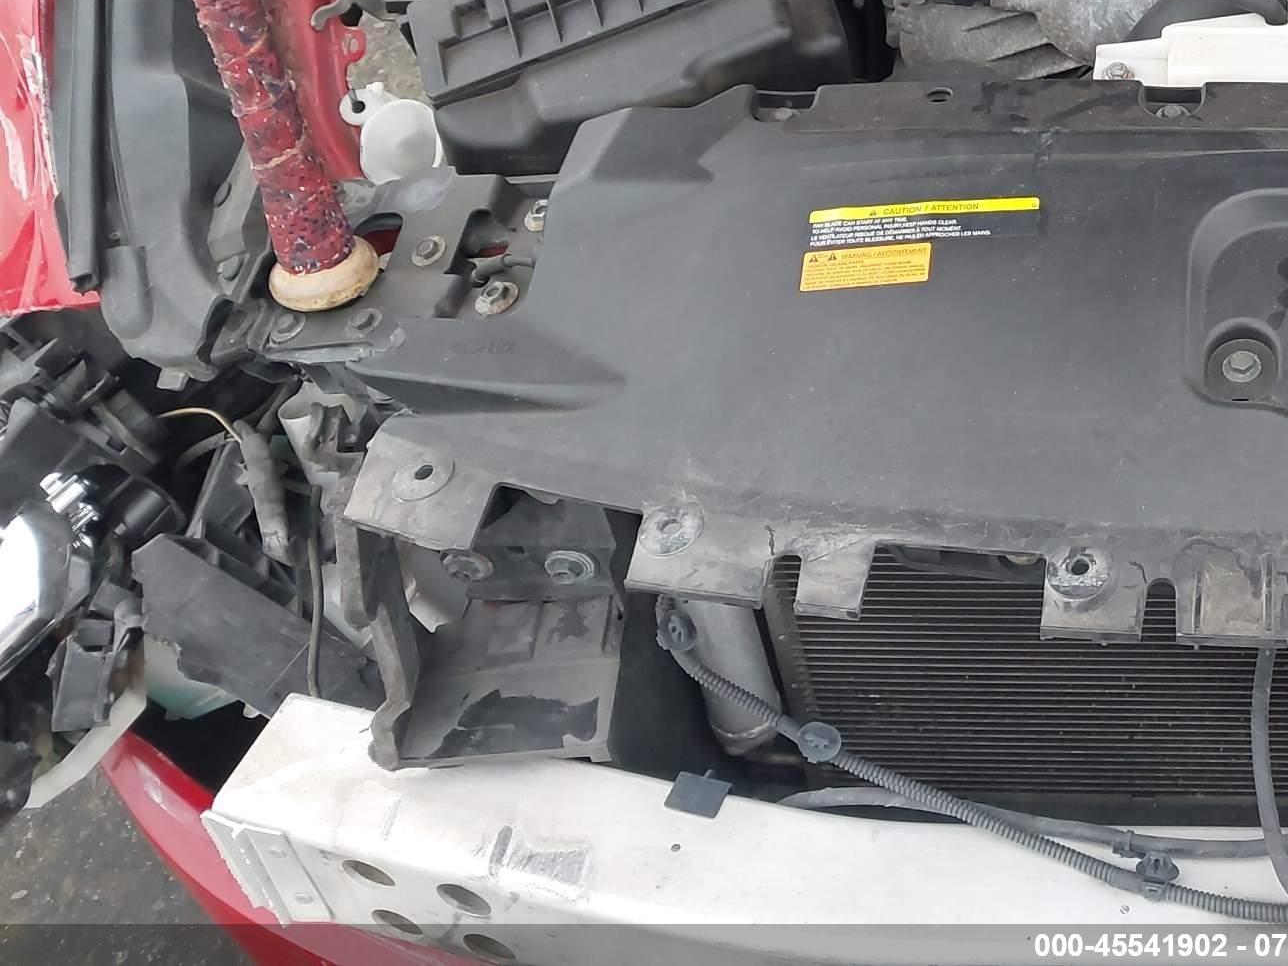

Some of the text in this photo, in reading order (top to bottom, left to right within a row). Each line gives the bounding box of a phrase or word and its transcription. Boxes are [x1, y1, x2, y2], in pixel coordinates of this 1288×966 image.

[883, 206, 922, 215] CAUTION
[931, 203, 979, 211] ATTENTION
[841, 251, 872, 259] WARNING
